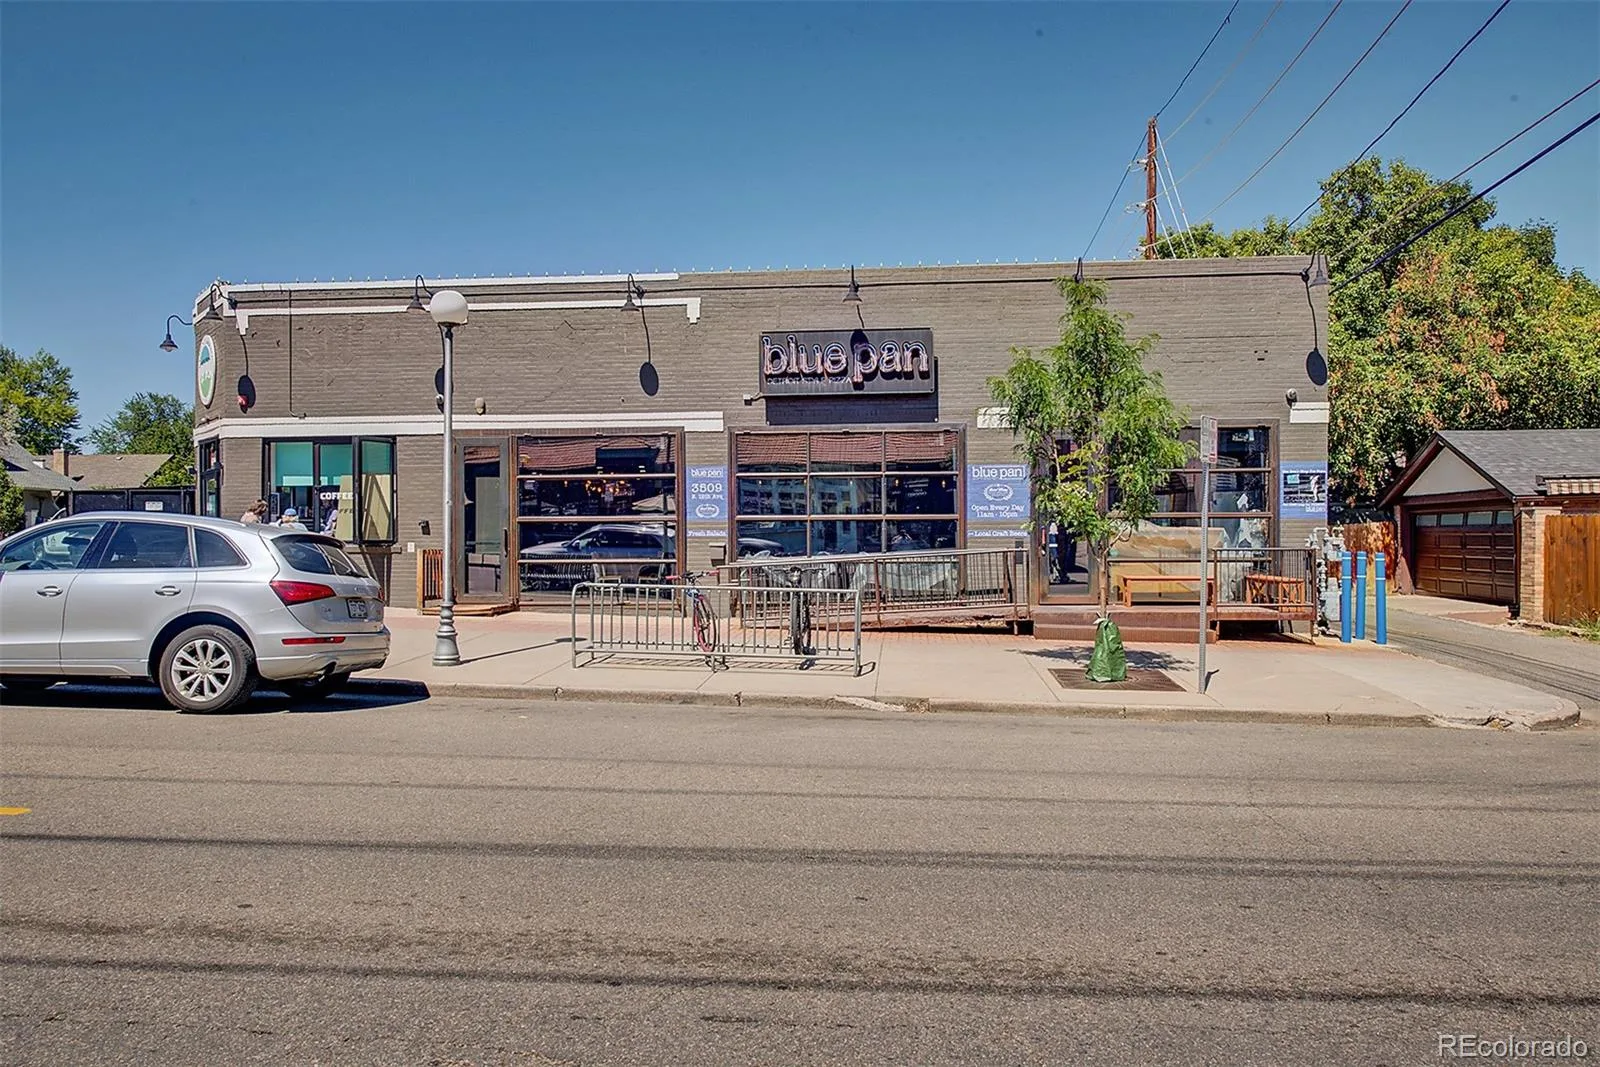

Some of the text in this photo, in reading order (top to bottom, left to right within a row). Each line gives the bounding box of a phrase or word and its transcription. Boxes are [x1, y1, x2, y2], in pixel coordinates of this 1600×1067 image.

[762, 335, 929, 383] blue pan
[691, 468, 722, 478] blue pan
[972, 466, 1023, 480] blue pan
[320, 492, 353, 500] COFFEE
[1011, 504, 1025, 512] Day
[1000, 511, 1018, 519] 10pm
